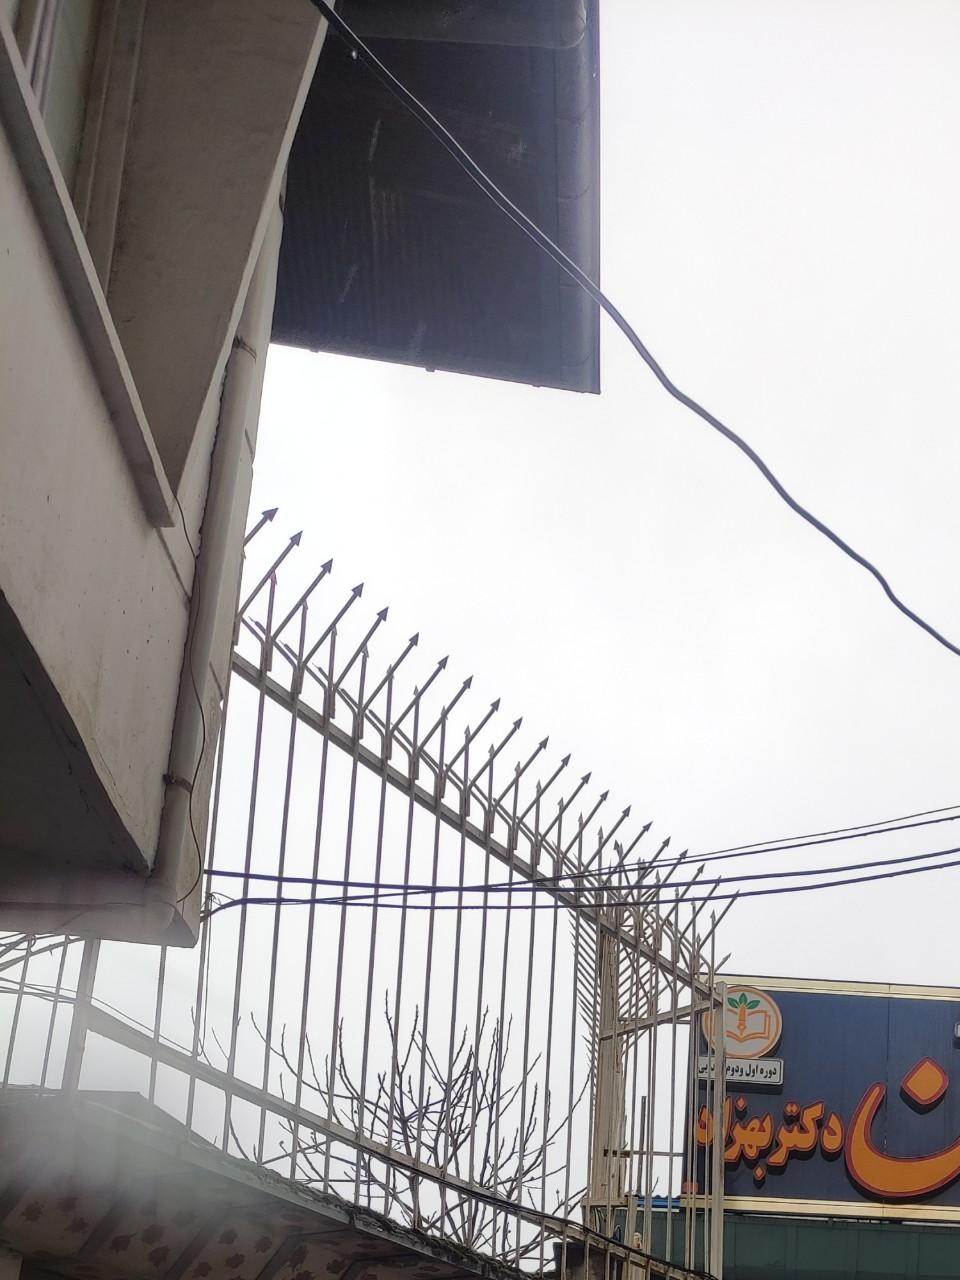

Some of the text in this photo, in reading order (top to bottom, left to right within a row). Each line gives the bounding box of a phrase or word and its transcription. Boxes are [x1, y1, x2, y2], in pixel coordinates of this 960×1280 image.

[745, 1063, 758, 1078] اول
[760, 1066, 777, 1079] دوره
[767, 1101, 844, 1166] دکتر
